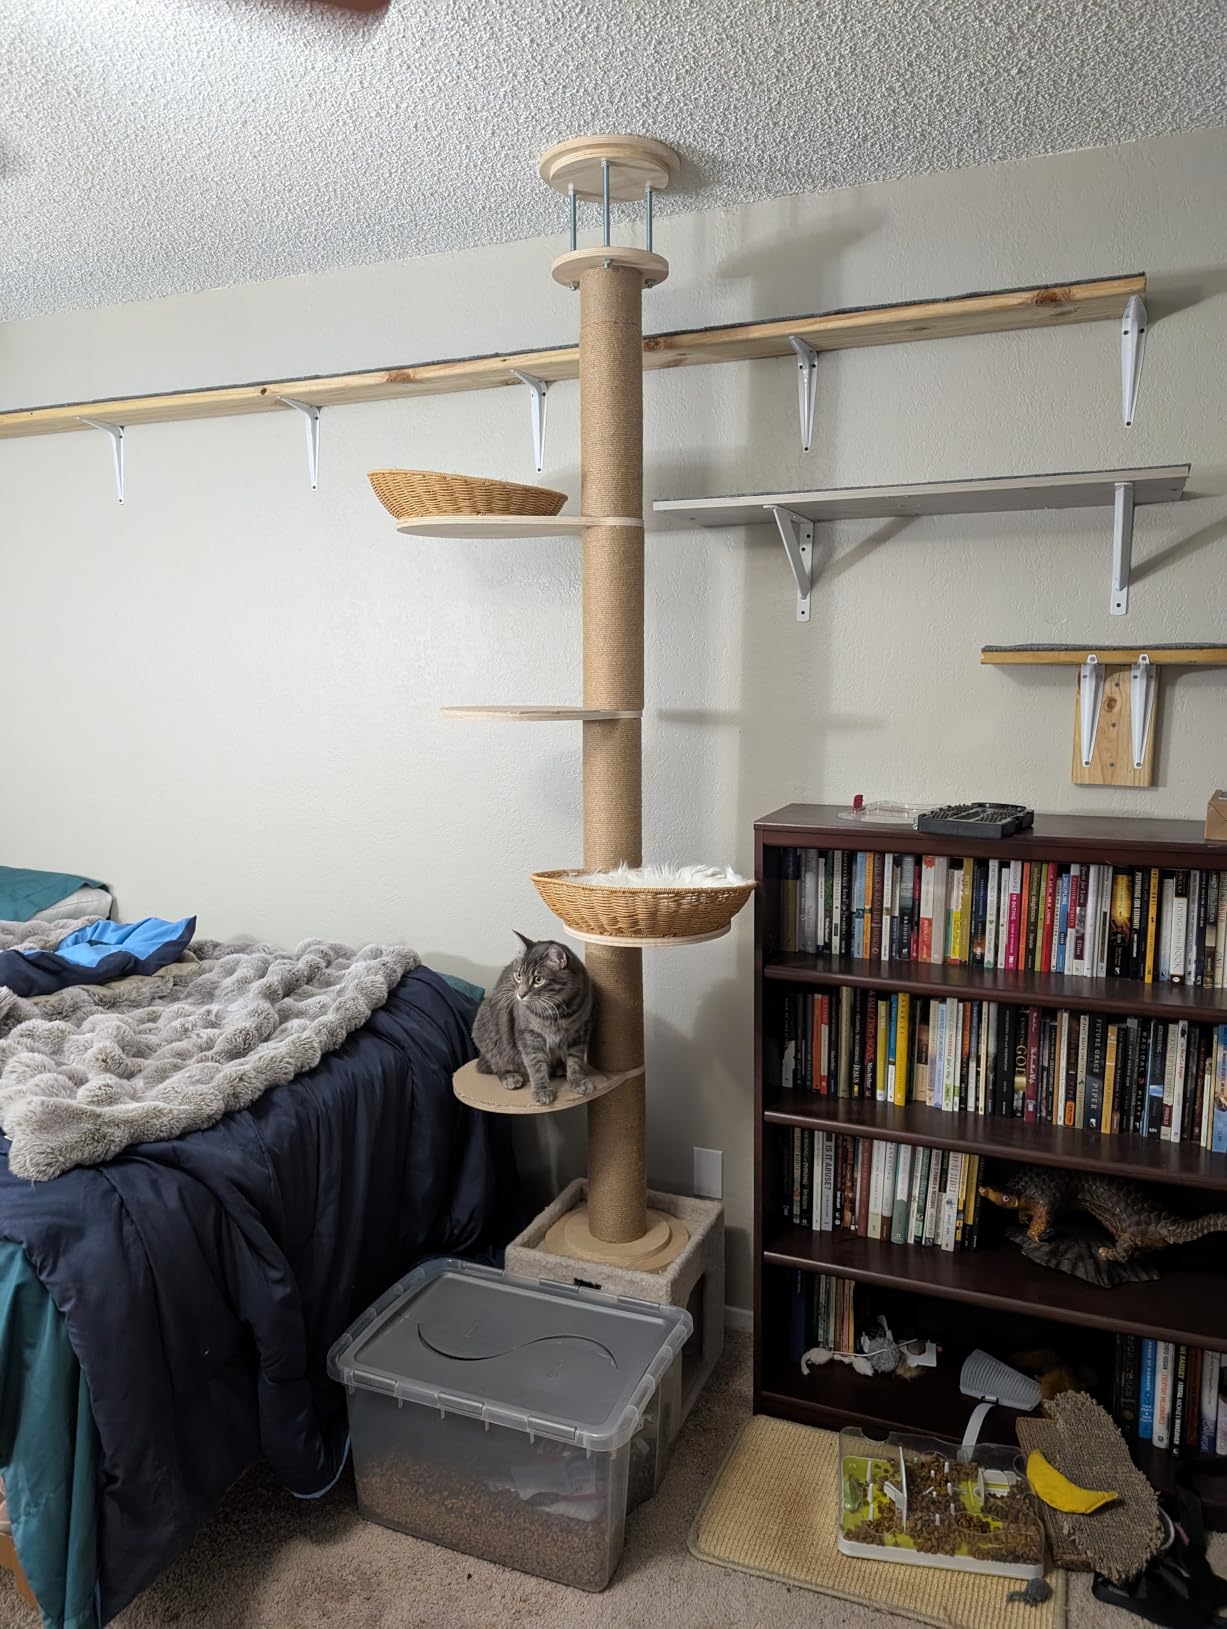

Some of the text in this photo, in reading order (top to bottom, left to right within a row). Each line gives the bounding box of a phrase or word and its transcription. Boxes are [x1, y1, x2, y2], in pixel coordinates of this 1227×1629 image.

[1138, 1031, 1147, 1073] RADICAL
[853, 1064, 861, 1083] JESUS
[1090, 1083, 1098, 1109] PIPER
[824, 1162, 832, 1191] ABUSE?
